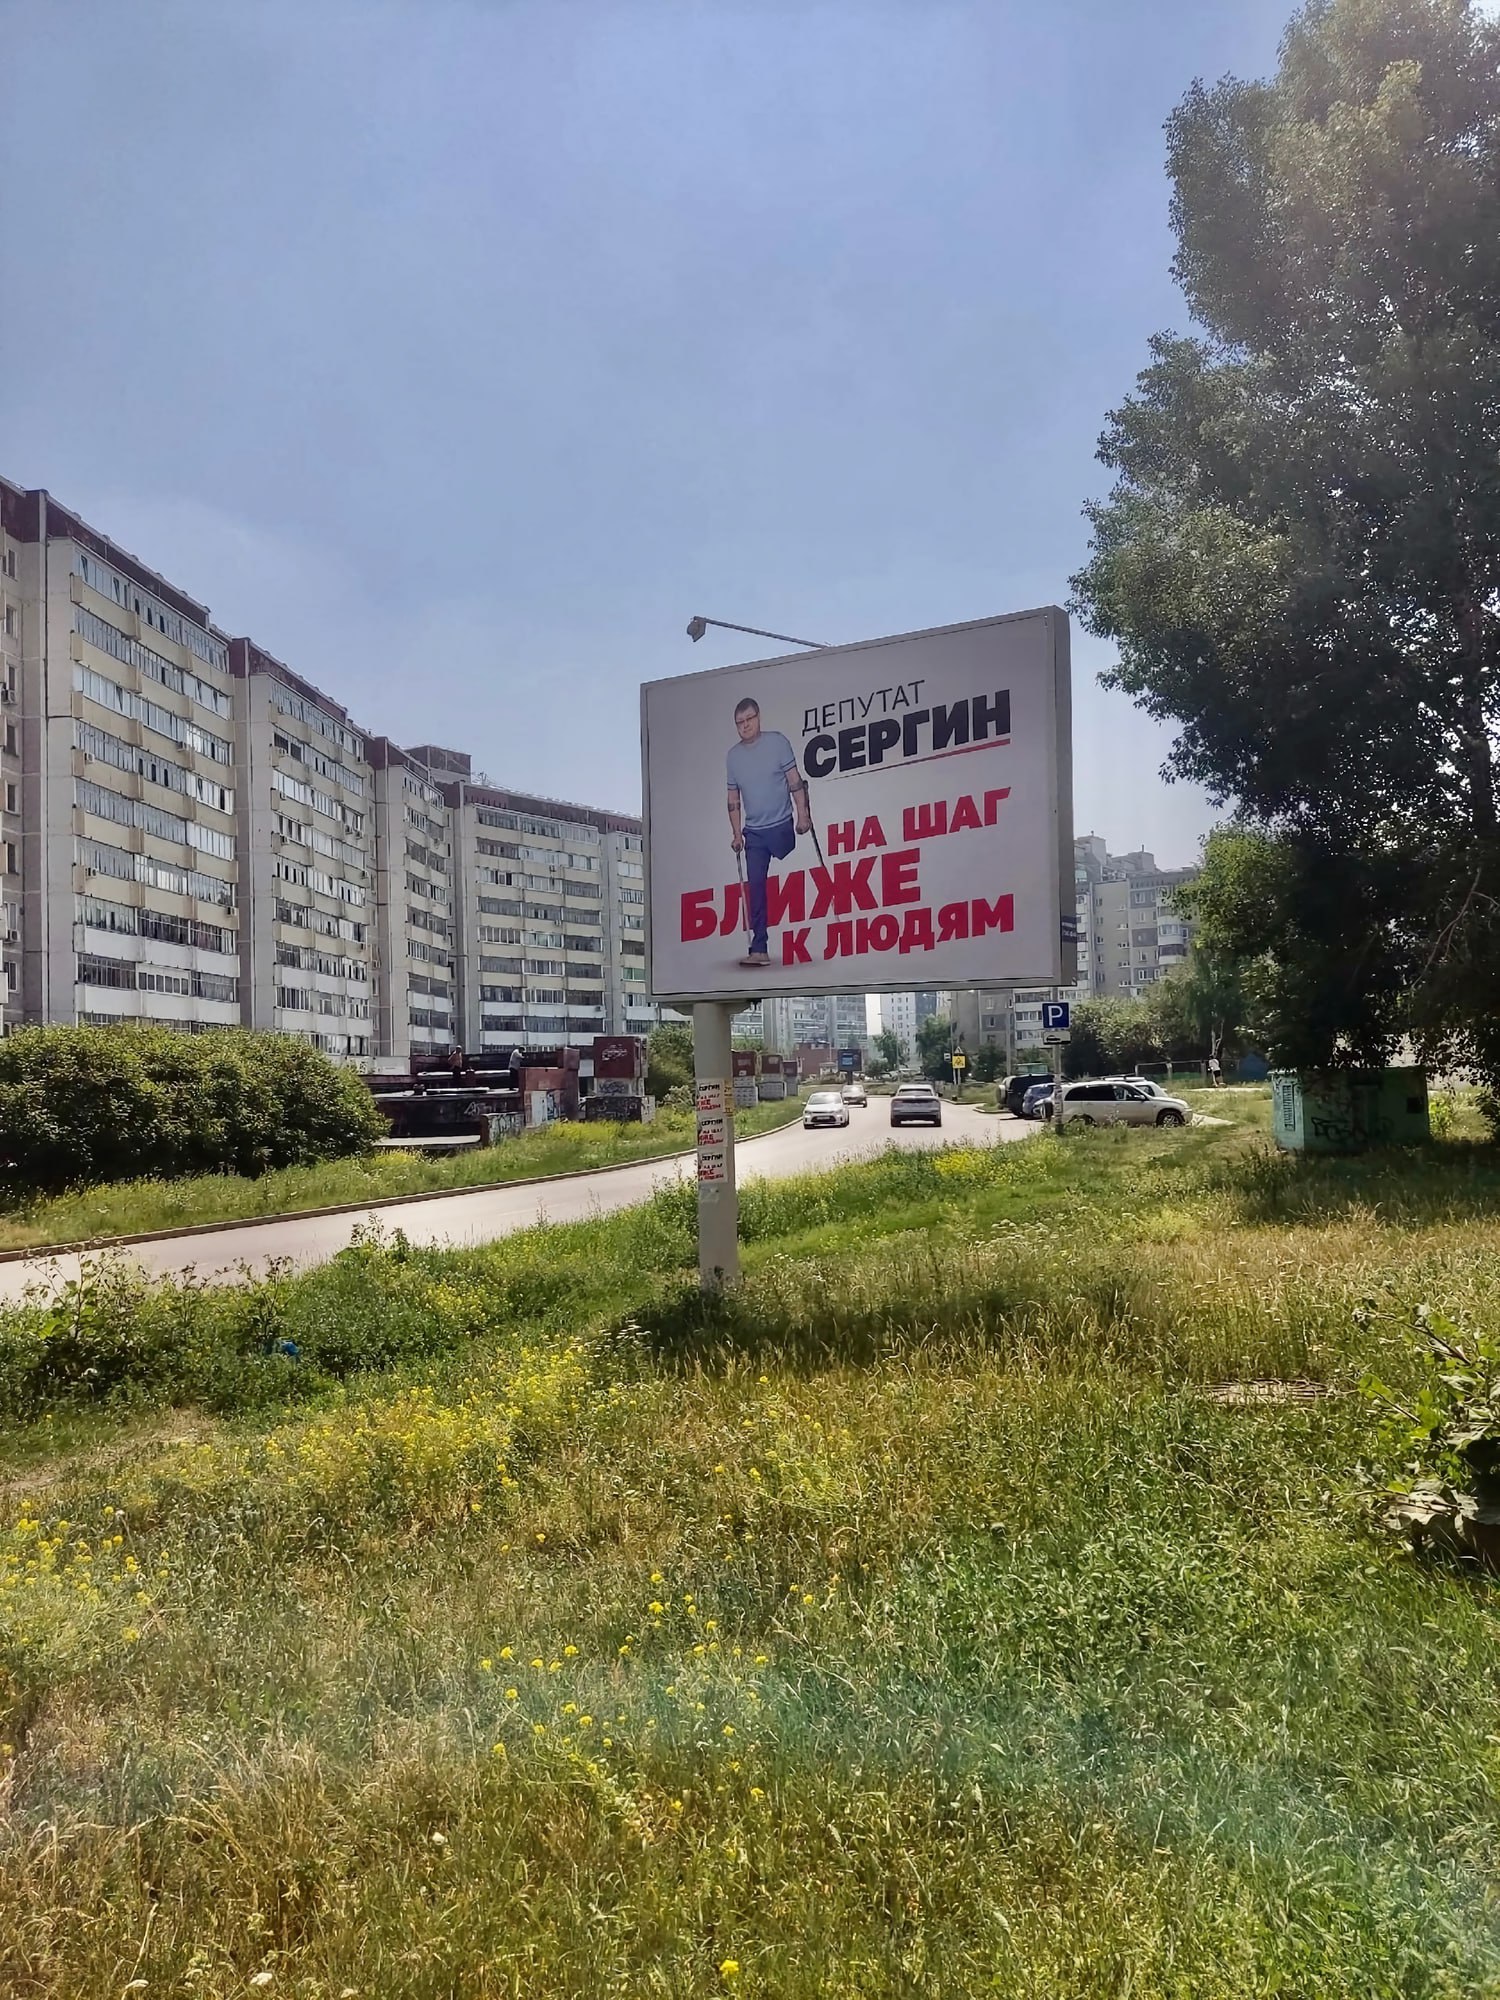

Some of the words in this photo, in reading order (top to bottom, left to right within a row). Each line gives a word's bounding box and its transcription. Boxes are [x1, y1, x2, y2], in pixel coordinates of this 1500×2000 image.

[801, 680, 925, 736] ДЕПУТАТ
[803, 689, 1011, 779] СЕРГИН
[827, 816, 888, 857] НА
[903, 787, 1011, 842] ШАГ
[681, 848, 920, 942] БЛИЖЕ
[782, 928, 812, 966] К
[823, 893, 1015, 961] ЛЮДЯМ
[1048, 1006, 1063, 1026] P
